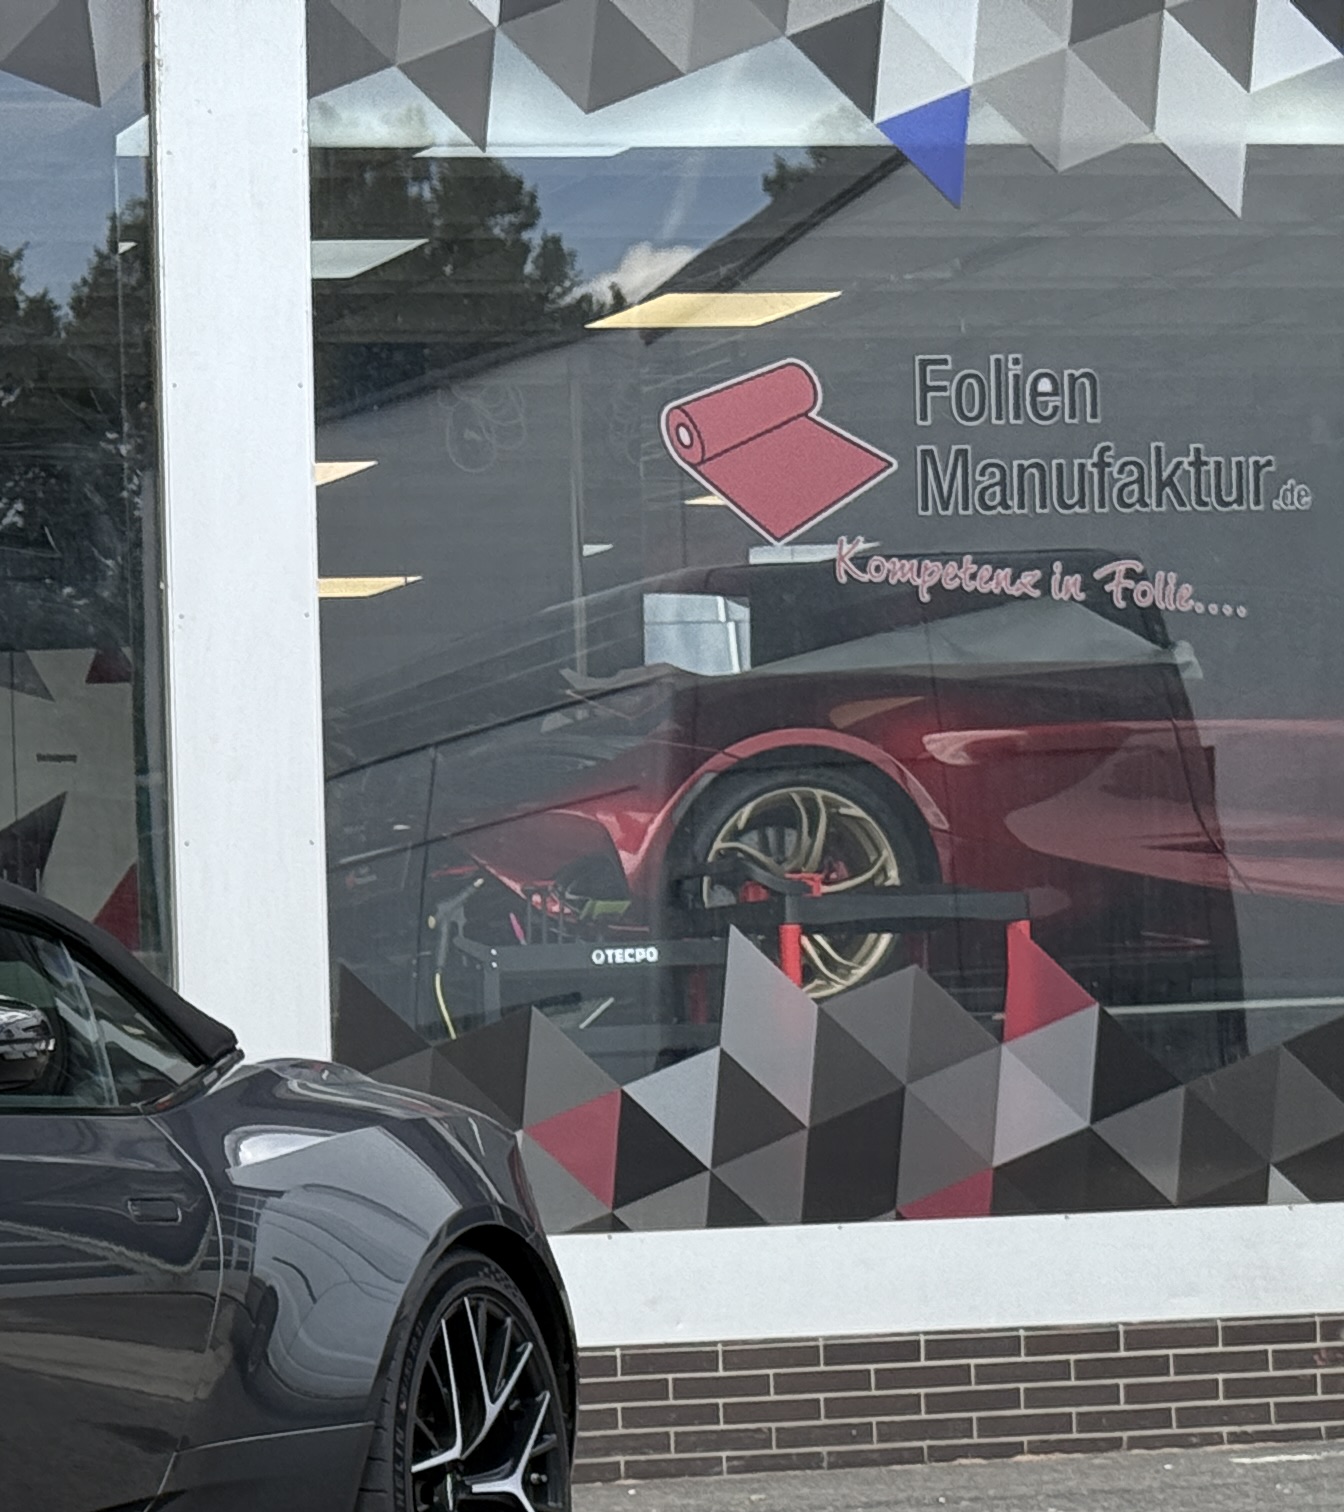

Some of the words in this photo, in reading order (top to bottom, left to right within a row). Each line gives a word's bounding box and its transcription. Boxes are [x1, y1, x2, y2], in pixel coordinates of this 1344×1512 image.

[913, 354, 1102, 427] Folien
[834, 535, 1042, 603] Kompetenz
[1050, 560, 1086, 601] in
